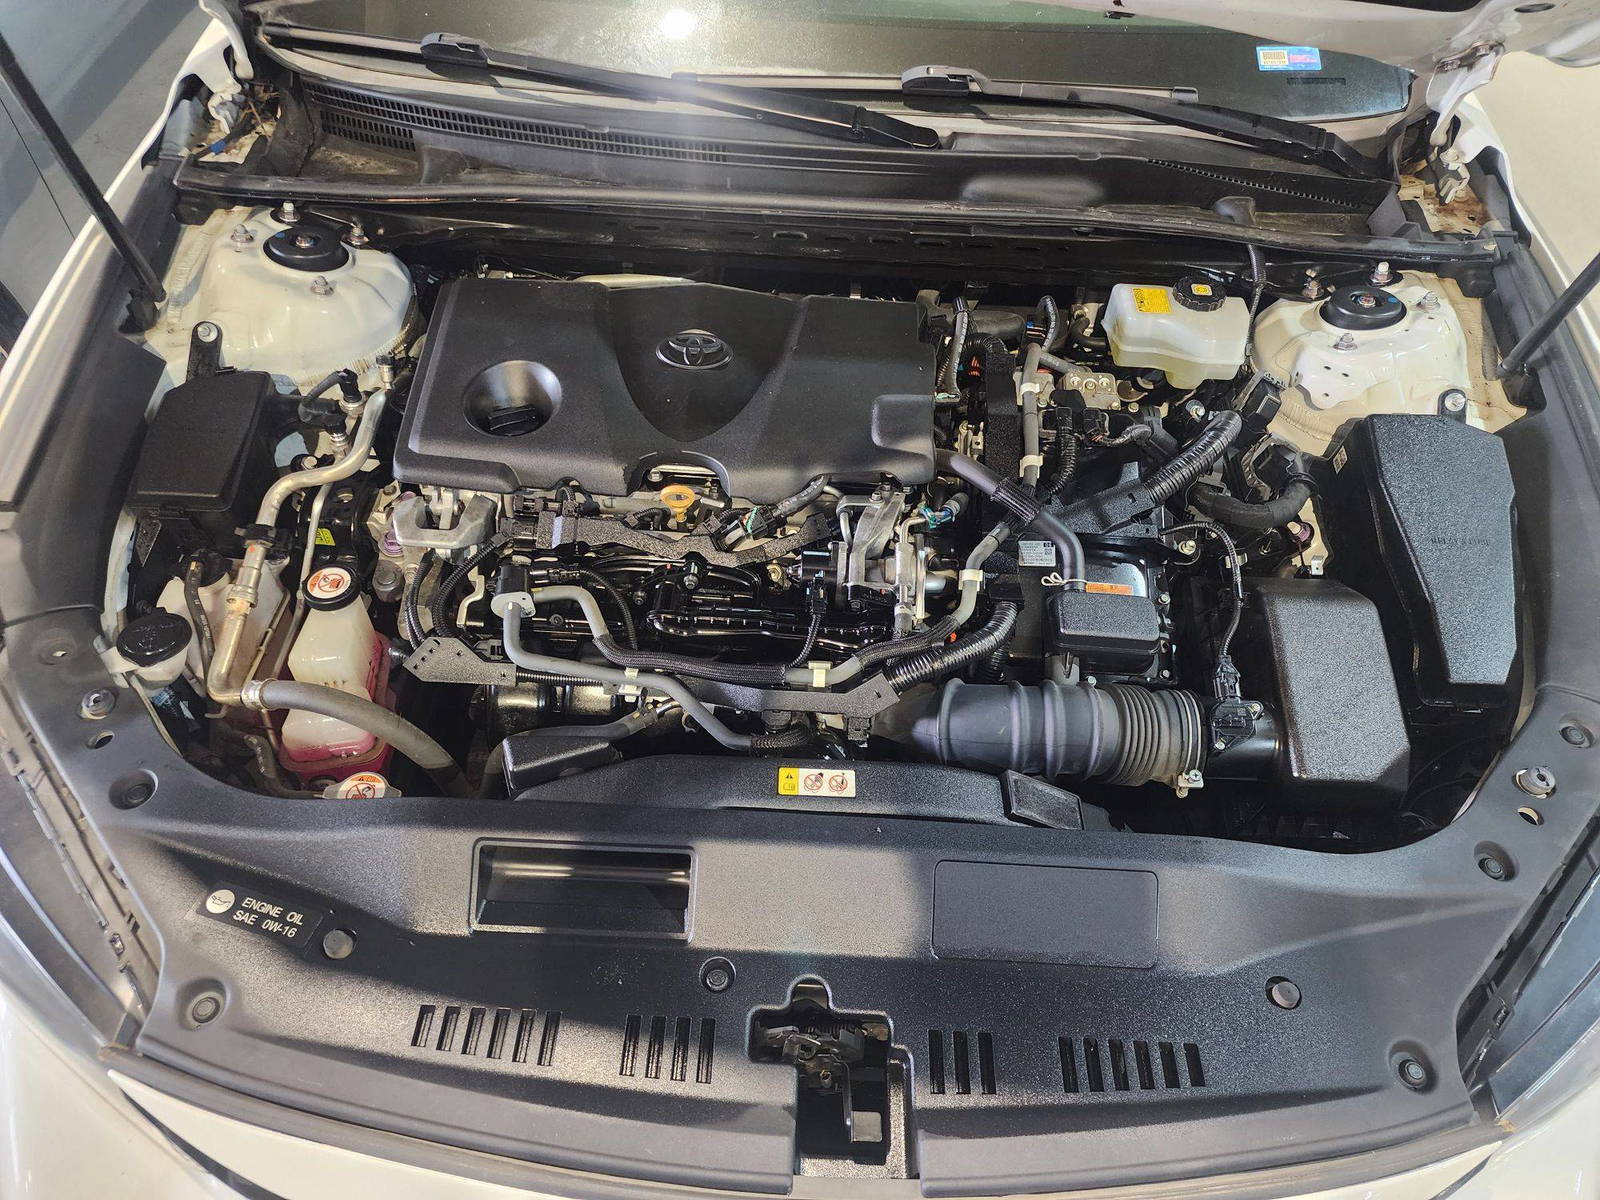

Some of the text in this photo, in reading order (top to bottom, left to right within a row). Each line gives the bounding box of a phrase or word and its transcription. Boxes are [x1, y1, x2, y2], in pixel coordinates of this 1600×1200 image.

[232, 909, 298, 938] SAE 0W-16
[241, 897, 304, 925] ENGINE OIL
